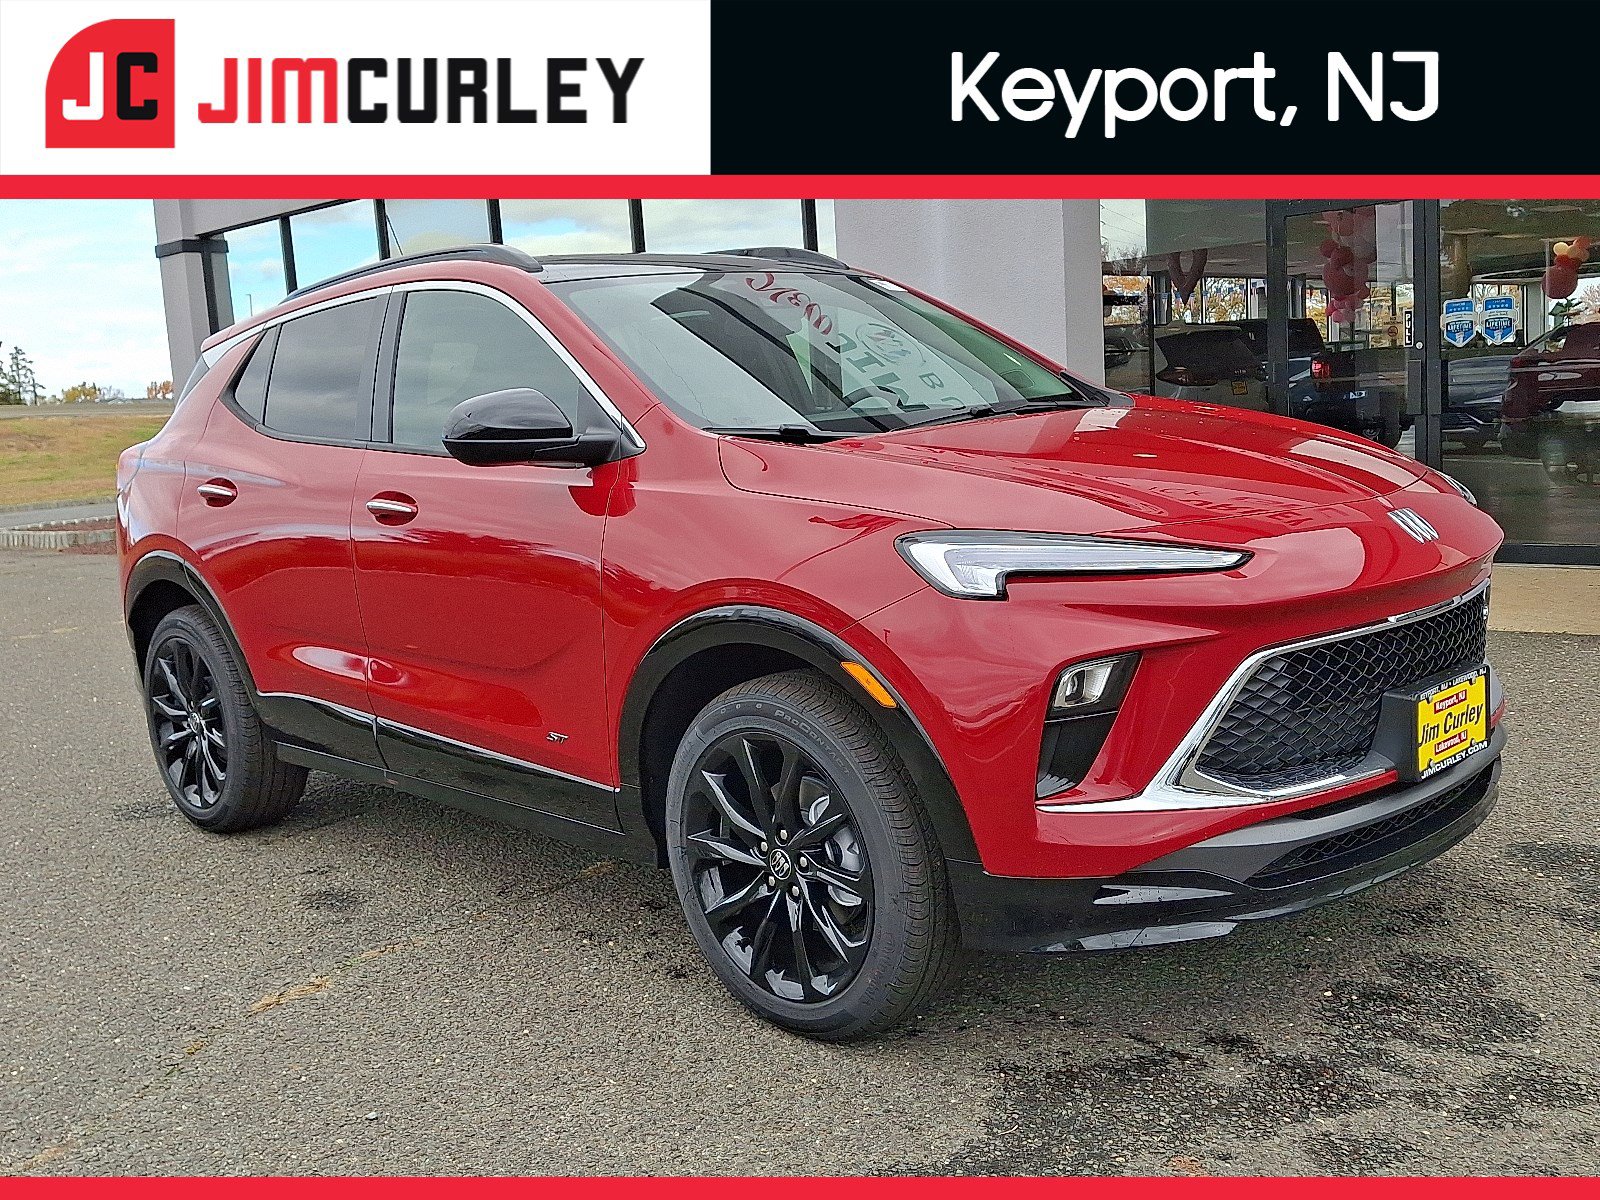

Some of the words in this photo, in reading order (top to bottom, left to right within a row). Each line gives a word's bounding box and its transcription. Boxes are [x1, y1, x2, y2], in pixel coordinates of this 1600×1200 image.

[1479, 667, 1487, 675] NJ
[1435, 694, 1459, 710] Keyport,
[1459, 690, 1466, 700] NJ
[1418, 723, 1440, 747] Jim
[1443, 703, 1483, 734] Curley
[546, 731, 569, 744] ST
[1421, 740, 1488, 779] JIMCURLEY.COM
